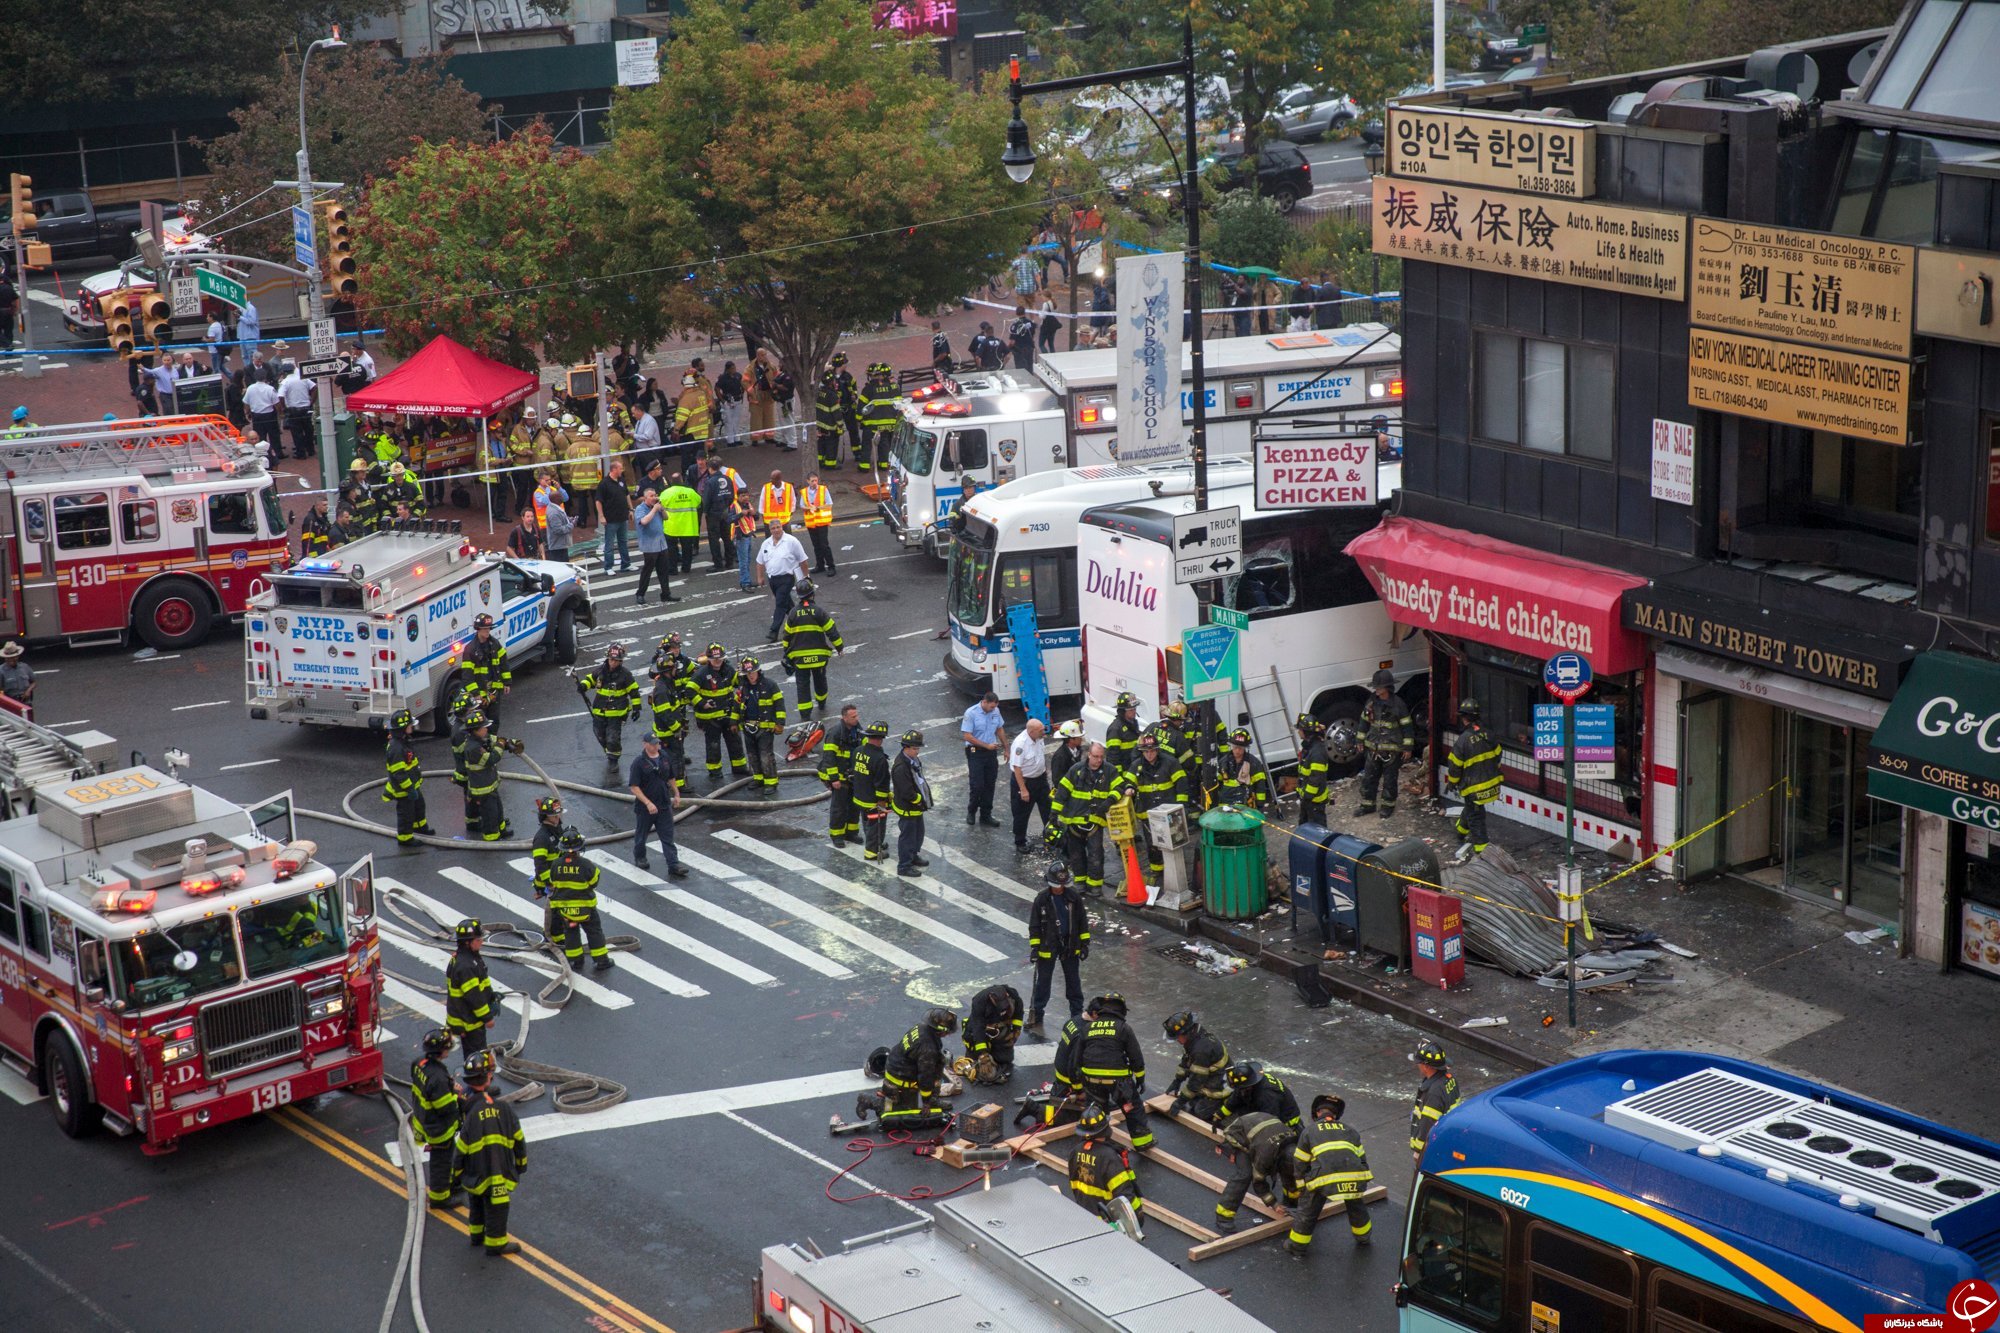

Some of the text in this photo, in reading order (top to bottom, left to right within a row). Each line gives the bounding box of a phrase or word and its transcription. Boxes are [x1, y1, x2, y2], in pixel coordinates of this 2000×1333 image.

[1398, 119, 1575, 176] 양인숙 한의원
[1400, 161, 1427, 173] #10A
[1382, 186, 1560, 251] 振威保險
[1631, 220, 1680, 242] Business
[1734, 228, 1748, 241] Dr.
[1752, 230, 1772, 244] Lau
[1776, 233, 1816, 250] Medical
[1820, 239, 1874, 259] Oncology,
[1596, 240, 1665, 266] Life & Health
[1733, 244, 1857, 270] (718) 353-1688 Suite 6B
[177, 279, 194, 287] WAIT
[1569, 260, 1677, 294] Professional Insurance Agent
[179, 288, 194, 296] FOR
[208, 277, 238, 301] Main St
[1739, 263, 1902, 323] 劉玉清 醫學博士
[175, 296, 199, 305] GREEN
[176, 304, 198, 314] LIGHT
[314, 321, 330, 329] WAIT
[1758, 308, 1838, 329] Pauline Y. Lau, M.D.
[315, 329, 329, 337] FOR
[1143, 296, 1159, 367] WINDSOR
[1696, 310, 1716, 322] Board
[1717, 313, 1746, 327] Certified
[1747, 318, 1753, 327] in
[1831, 331, 1844, 341] and
[1845, 333, 1872, 347] Internal
[1872, 338, 1904, 352] Medicine
[312, 337, 334, 345] GREEN
[314, 345, 333, 353] LIGHT
[306, 364, 321, 374] ONE
[328, 361, 345, 371] WAY
[1690, 336, 1901, 393] NEW YORK MEDICAL CAREER TRAINING CENTER
[1278, 377, 1352, 392] EMERGENCY
[1690, 366, 1727, 384] NURSING
[1756, 378, 1793, 395] MEDICAL
[1821, 388, 1871, 409] PHARMACH
[1873, 397, 1899, 414] TECH.
[1289, 388, 1341, 402] SERVICE
[1694, 386, 1712, 401] TEL.
[1144, 373, 1158, 440] SCHOOL
[1797, 409, 1899, 436] www.nymedtraining.com
[435, 436, 468, 448] COMMAND
[1654, 421, 1692, 457] FOR SALE
[1263, 442, 1370, 464] kennedy
[441, 458, 461, 467] POST
[1273, 467, 1361, 483] PIZZA &
[1653, 460, 1692, 486] STORE OFFICE
[1265, 487, 1366, 504] CHICKEN
[1653, 485, 1663, 496] 718
[1029, 523, 1050, 532] 7430
[1210, 518, 1237, 531] TRUCK
[1210, 535, 1237, 548] ROUTE
[69, 563, 107, 588] 130
[1182, 564, 1204, 576] THRU
[1085, 559, 1158, 611] Dahlia
[428, 589, 467, 622] POLICE
[297, 616, 345, 630] NYPD
[507, 606, 538, 638] NYPD
[1216, 609, 1245, 626] MAIN ST
[1448, 585, 1501, 631] fried
[1506, 601, 1593, 654] chicken
[291, 628, 354, 643] POLICE
[1045, 637, 1058, 645] City
[1200, 630, 1221, 639] BRONX
[1192, 637, 1230, 648] WHITESTONE
[1200, 645, 1222, 654] BRIDGE
[1634, 602, 1879, 689] MAIN STREET TOWER
[293, 663, 359, 676] EMERGENCY SERVICE
[1549, 683, 1589, 697] NO STANDING
[1536, 720, 1558, 731] Q25
[1536, 734, 1558, 745] Q34
[1536, 748, 1559, 759] Q50
[1879, 754, 1969, 791] 36-09 COFFEE
[64, 772, 161, 803] 138
[1416, 913, 1432, 922] FREE
[1416, 920, 1433, 929] DAILY
[1443, 913, 1459, 924] FREE
[1443, 918, 1459, 931] DAILY
[1418, 935, 1435, 952] am
[1444, 938, 1460, 955] am
[305, 1019, 347, 1047] N.Y.
[251, 1080, 292, 1113] 138
[1336, 1182, 1357, 1192] LOPEZ
[1500, 1186, 1531, 1208] 6027
